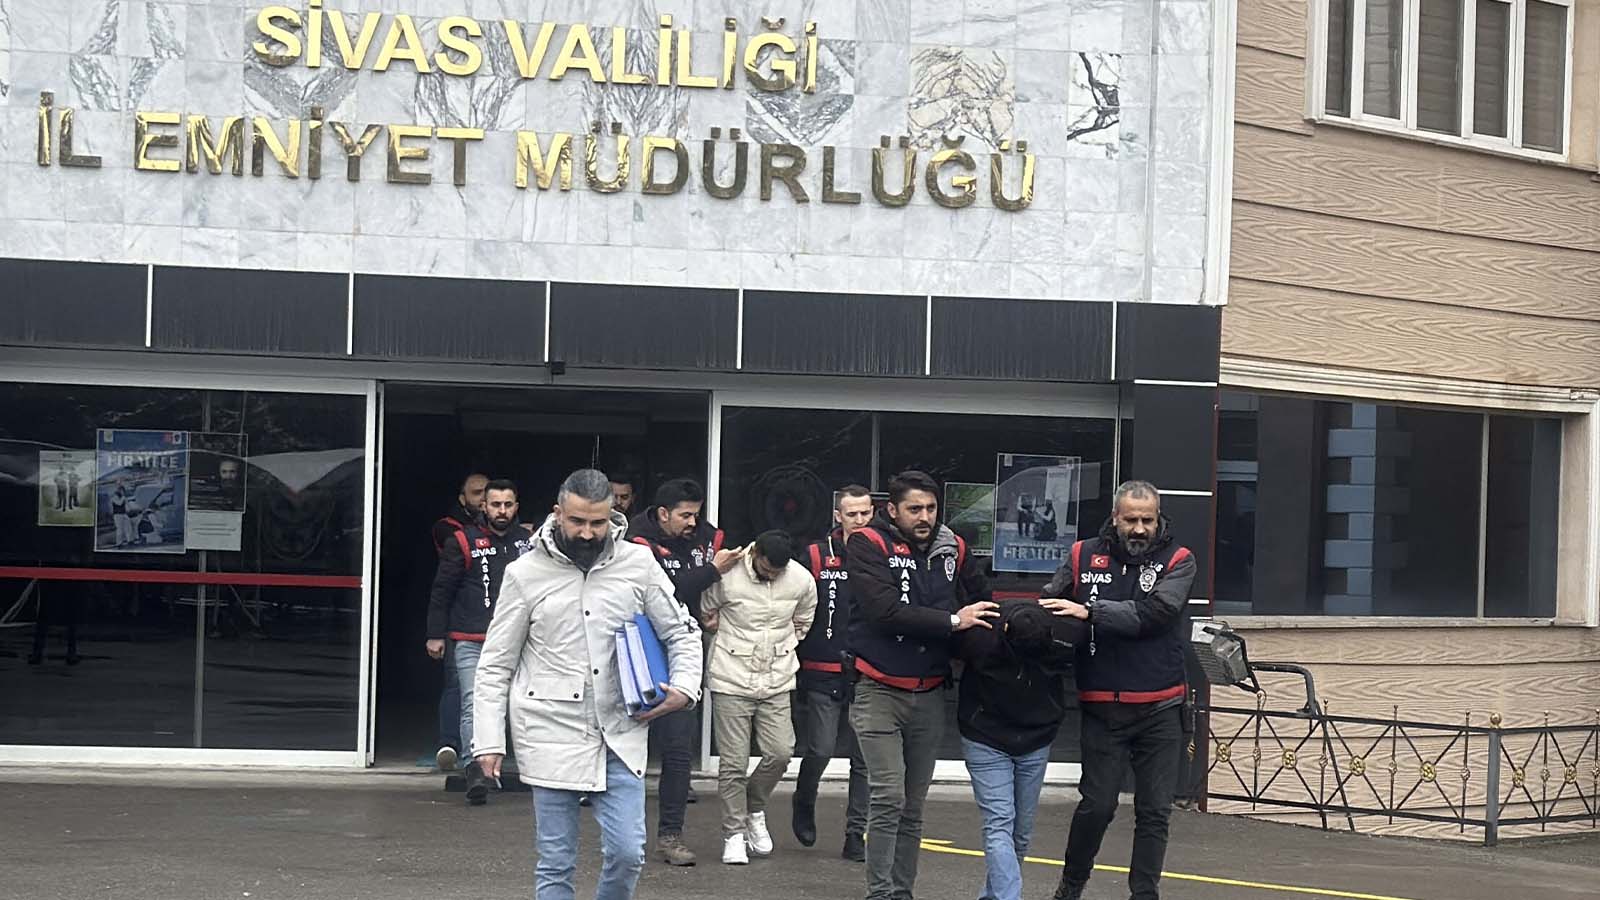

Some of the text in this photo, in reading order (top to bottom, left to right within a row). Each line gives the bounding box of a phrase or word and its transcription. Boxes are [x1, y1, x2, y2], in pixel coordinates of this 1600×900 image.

[253, 0, 818, 95] SİVAS VALİLİĞİ
[37, 90, 1036, 212] İL EMNİYET MÜDÜRLÜĞÜ
[888, 555, 917, 570] SİVAS
[820, 569, 849, 580] SİVAS
[1080, 571, 1113, 584] SİVAS
